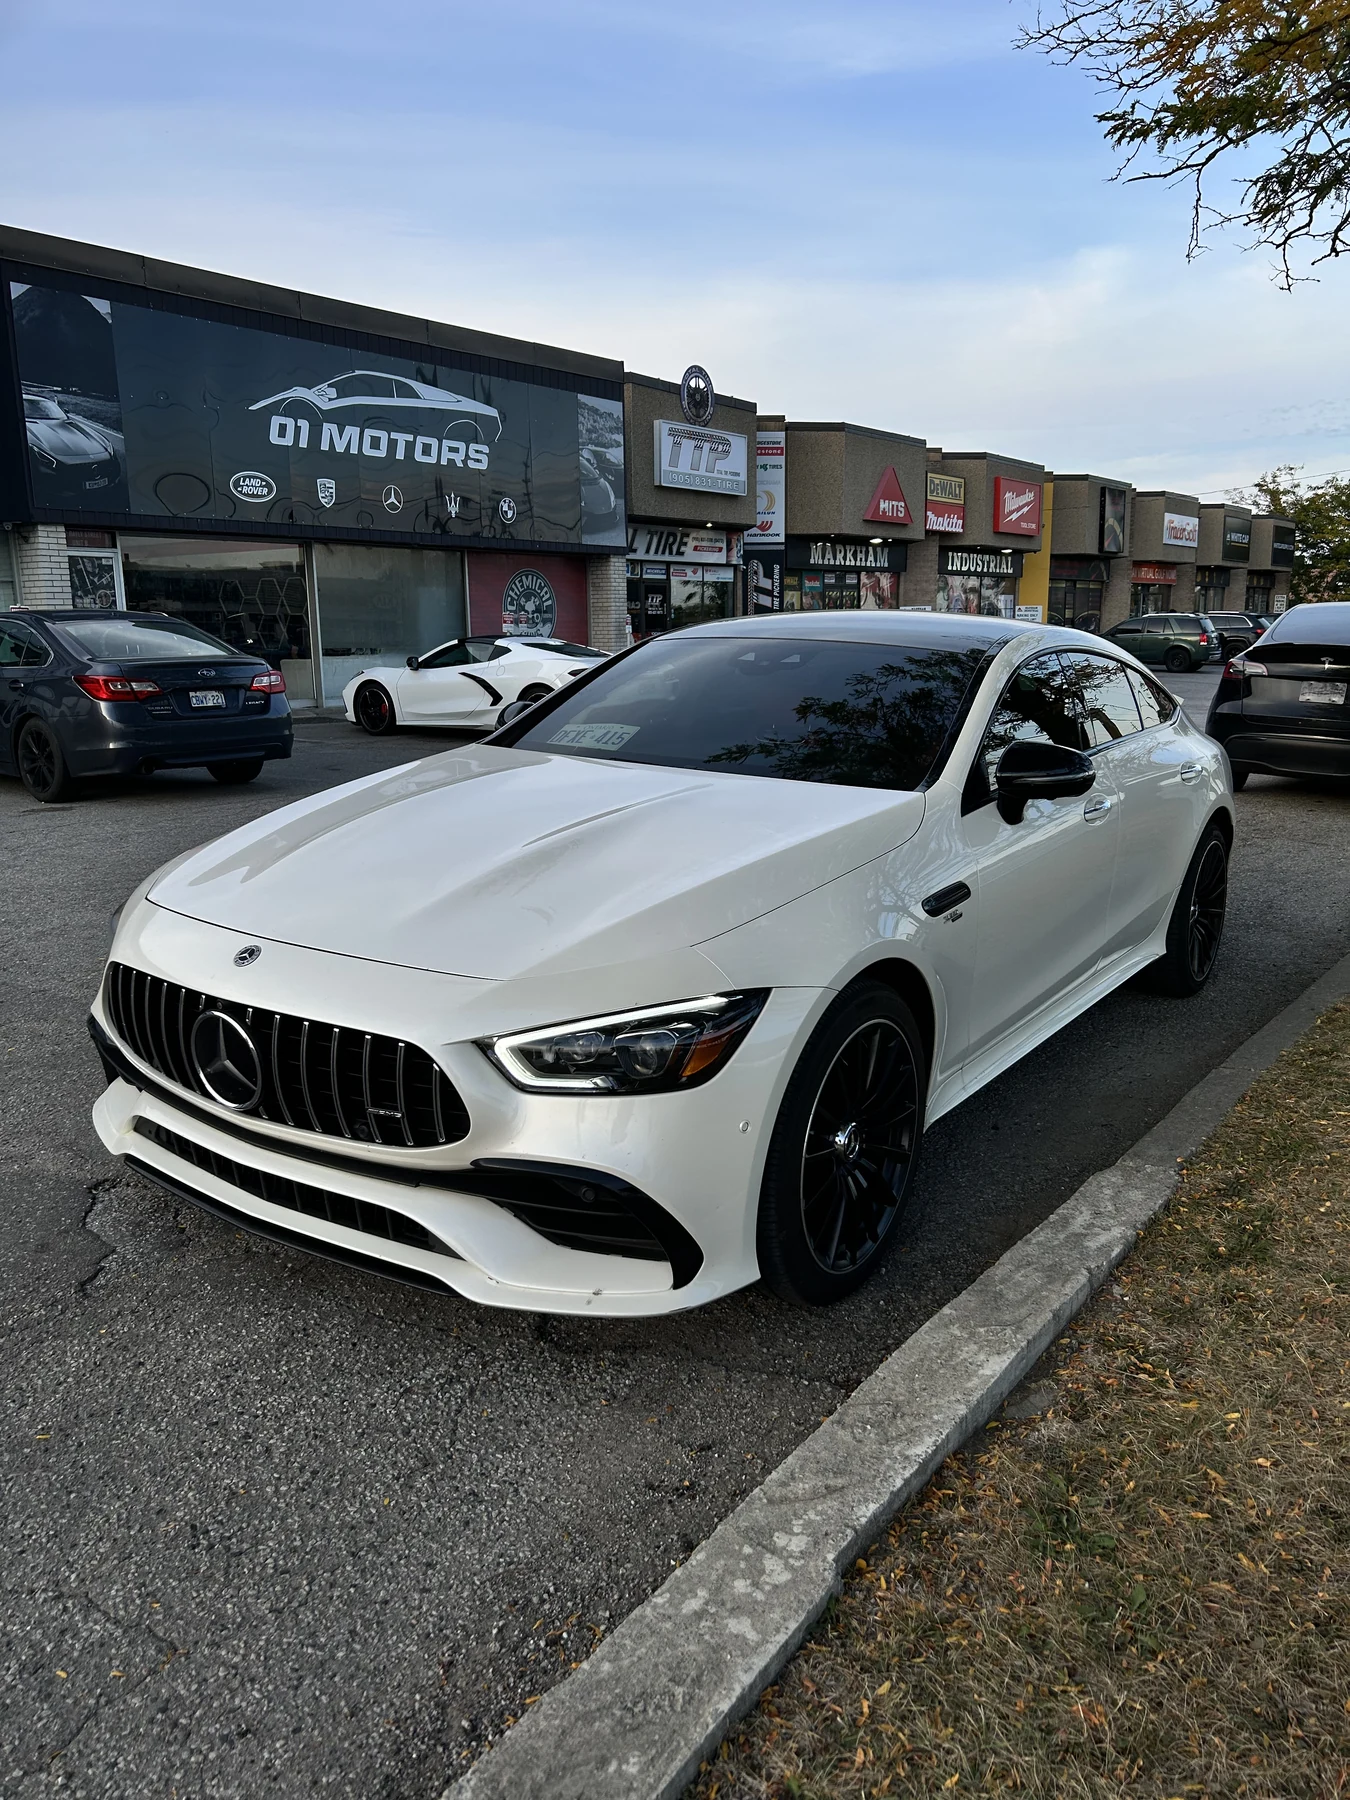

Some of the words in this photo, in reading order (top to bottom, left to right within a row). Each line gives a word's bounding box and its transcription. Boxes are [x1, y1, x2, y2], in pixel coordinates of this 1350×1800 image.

[269, 415, 310, 448] 01
[321, 422, 490, 470] MOTORS
[667, 427, 732, 474] TTP
[240, 478, 261, 486] LAND
[242, 486, 268, 496] ROVER
[669, 472, 694, 484] (905)
[696, 475, 740, 491] 831-TIRE
[880, 499, 905, 518] MITS
[644, 529, 691, 557] TIRE
[810, 542, 889, 568] MARKHAM
[947, 551, 1014, 574] INDUSTRIAL
[506, 575, 552, 611] CHEMICAL
[595, 730, 631, 745] 415
